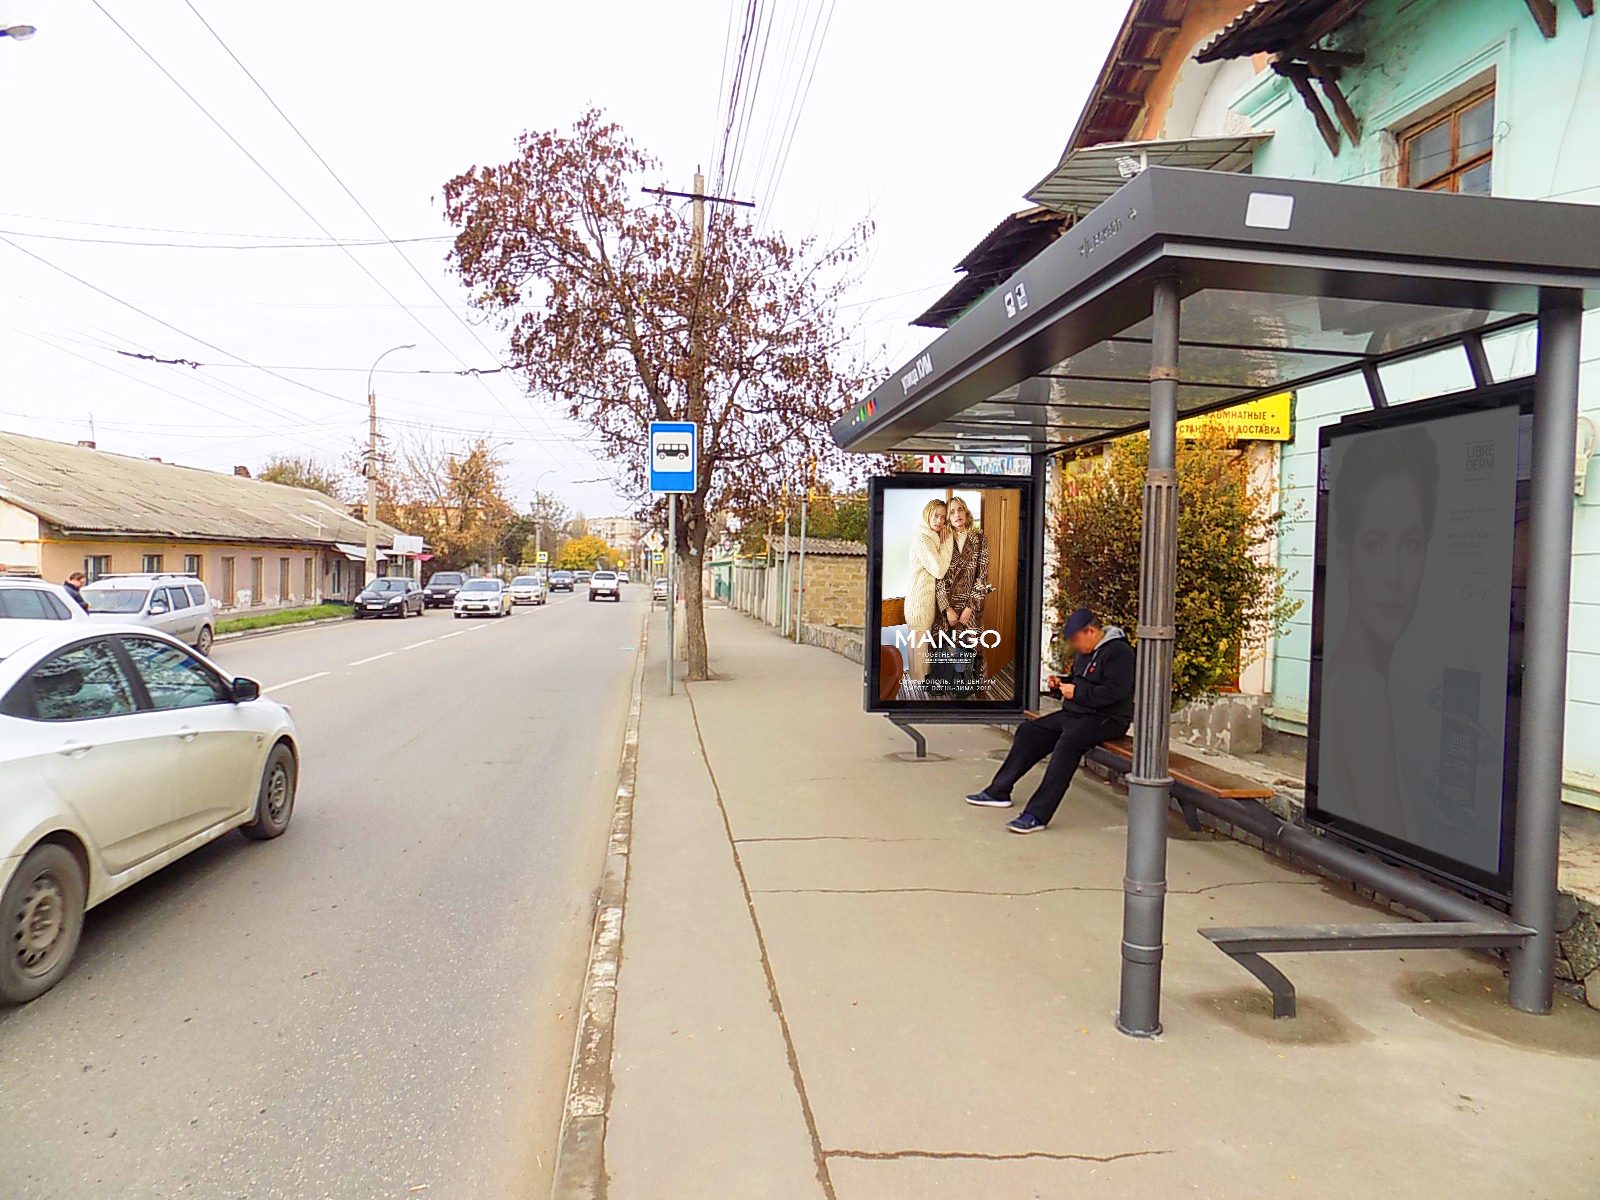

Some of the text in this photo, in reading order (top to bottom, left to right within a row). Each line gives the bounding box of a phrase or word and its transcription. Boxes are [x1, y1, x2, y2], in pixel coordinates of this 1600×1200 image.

[1237, 424, 1281, 435] ДОСТАВКА
[1466, 443, 1495, 459] LIBRE
[1465, 456, 1495, 472] DERM
[895, 629, 1002, 649] MANGO
